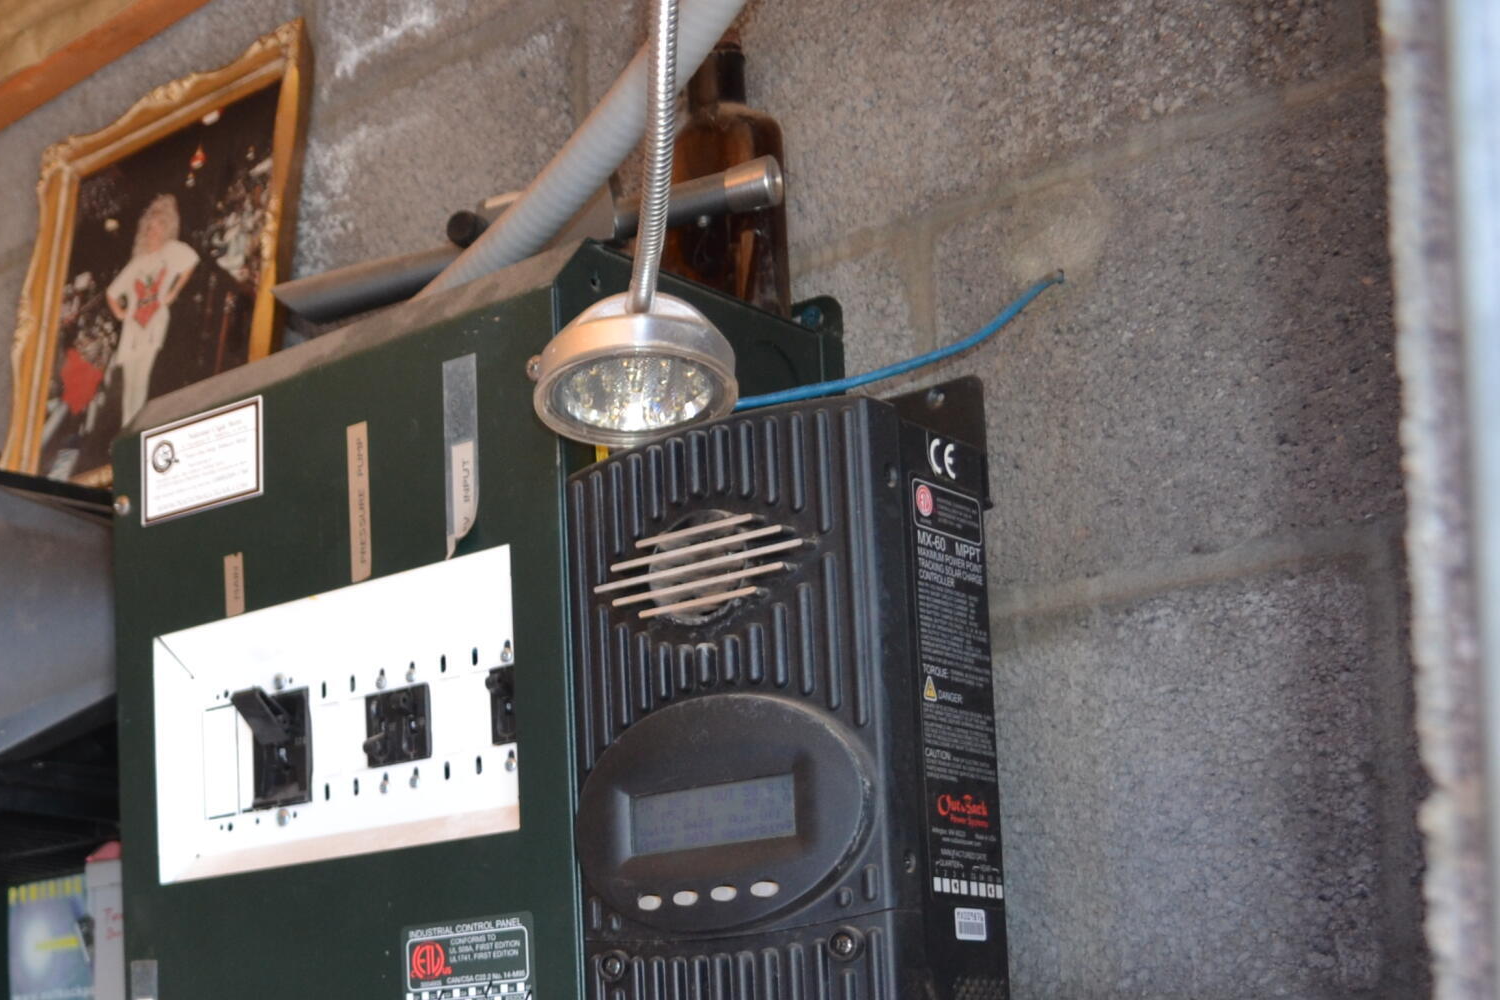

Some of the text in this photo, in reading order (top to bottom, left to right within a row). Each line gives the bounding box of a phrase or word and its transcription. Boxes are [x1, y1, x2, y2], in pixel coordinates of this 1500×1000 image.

[461, 457, 471, 503] INPUT
[917, 530, 980, 562] MX-60 MPPT
[917, 546, 982, 573] MAXIMUM POWER POINT
[918, 557, 983, 585] TRACKING SOLAR CHARGE
[919, 568, 955, 587] CONTROLLER
[408, 917, 522, 939] INDUSTRIAL CONTROL PANEL
[450, 933, 496, 945] CONFORMS TO
[474, 951, 491, 960] FIRST
[493, 949, 519, 958] EDITION
[476, 942, 493, 951] FIRST
[494, 940, 520, 950] EDITION
